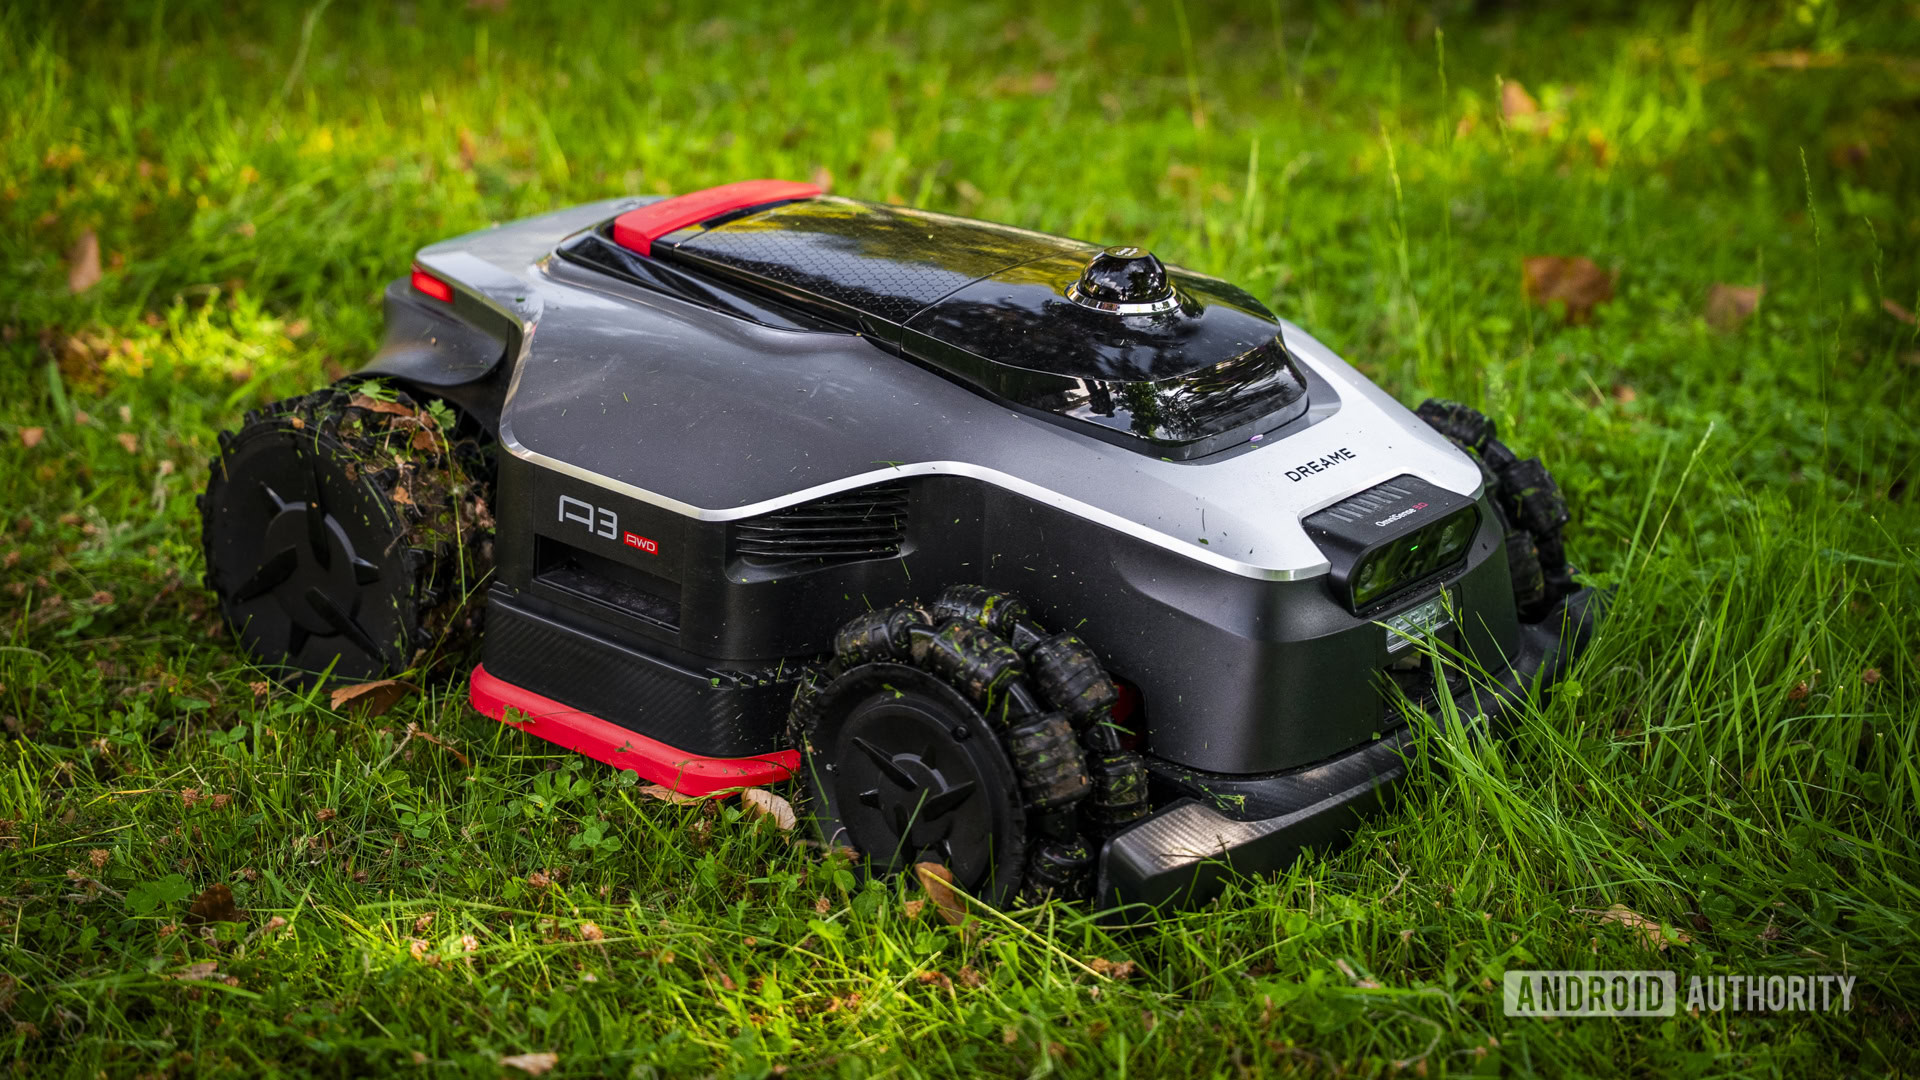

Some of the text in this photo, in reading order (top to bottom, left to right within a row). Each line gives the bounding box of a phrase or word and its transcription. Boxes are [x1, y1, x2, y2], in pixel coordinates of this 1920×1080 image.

[1284, 447, 1357, 482] DREAME
[558, 494, 656, 552] A3 AWD
[1375, 508, 1417, 527] OmniSense
